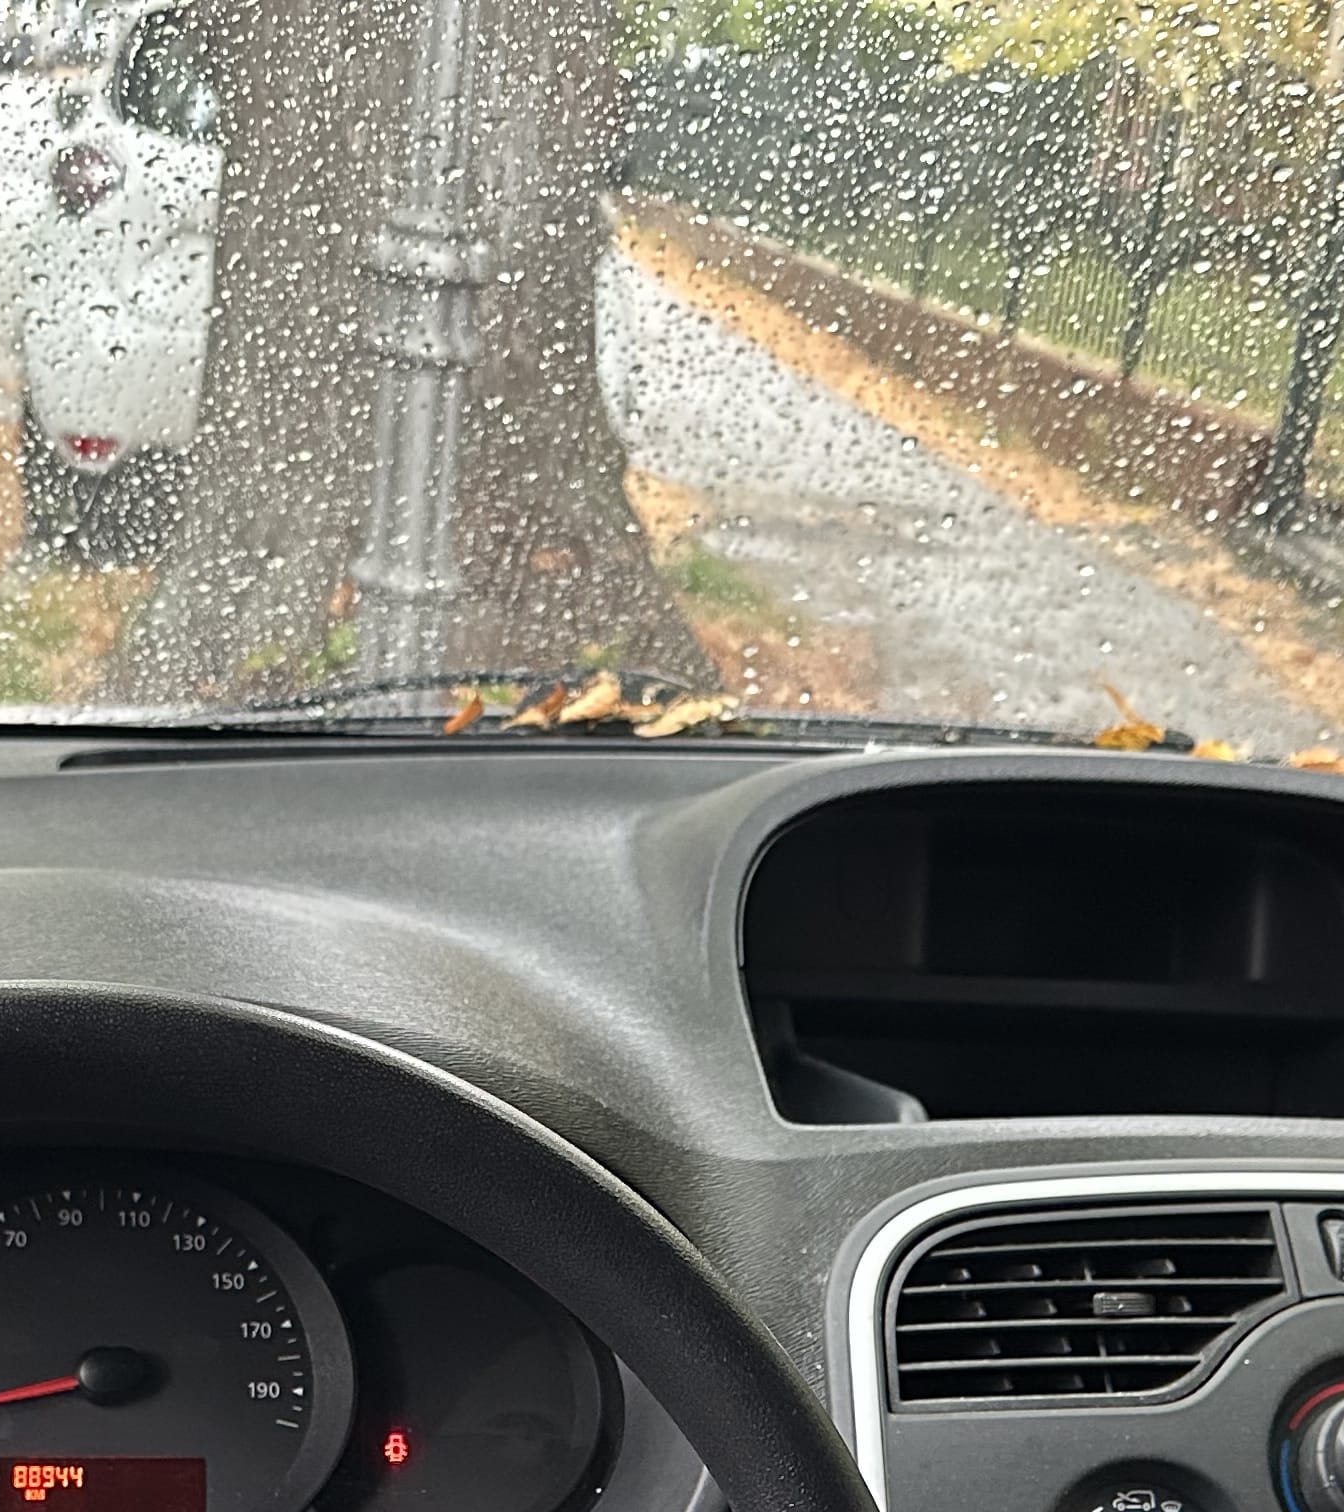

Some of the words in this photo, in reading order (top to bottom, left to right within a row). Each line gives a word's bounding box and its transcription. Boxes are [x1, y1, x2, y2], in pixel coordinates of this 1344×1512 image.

[58, 1208, 83, 1227] 90
[118, 1210, 151, 1228] 110
[4, 1230, 28, 1248] 70
[173, 1233, 206, 1252] 130
[212, 1272, 245, 1292] 150
[240, 1320, 272, 1340] 170
[247, 1381, 280, 1399] 190
[13, 1465, 84, 1488] 88944
